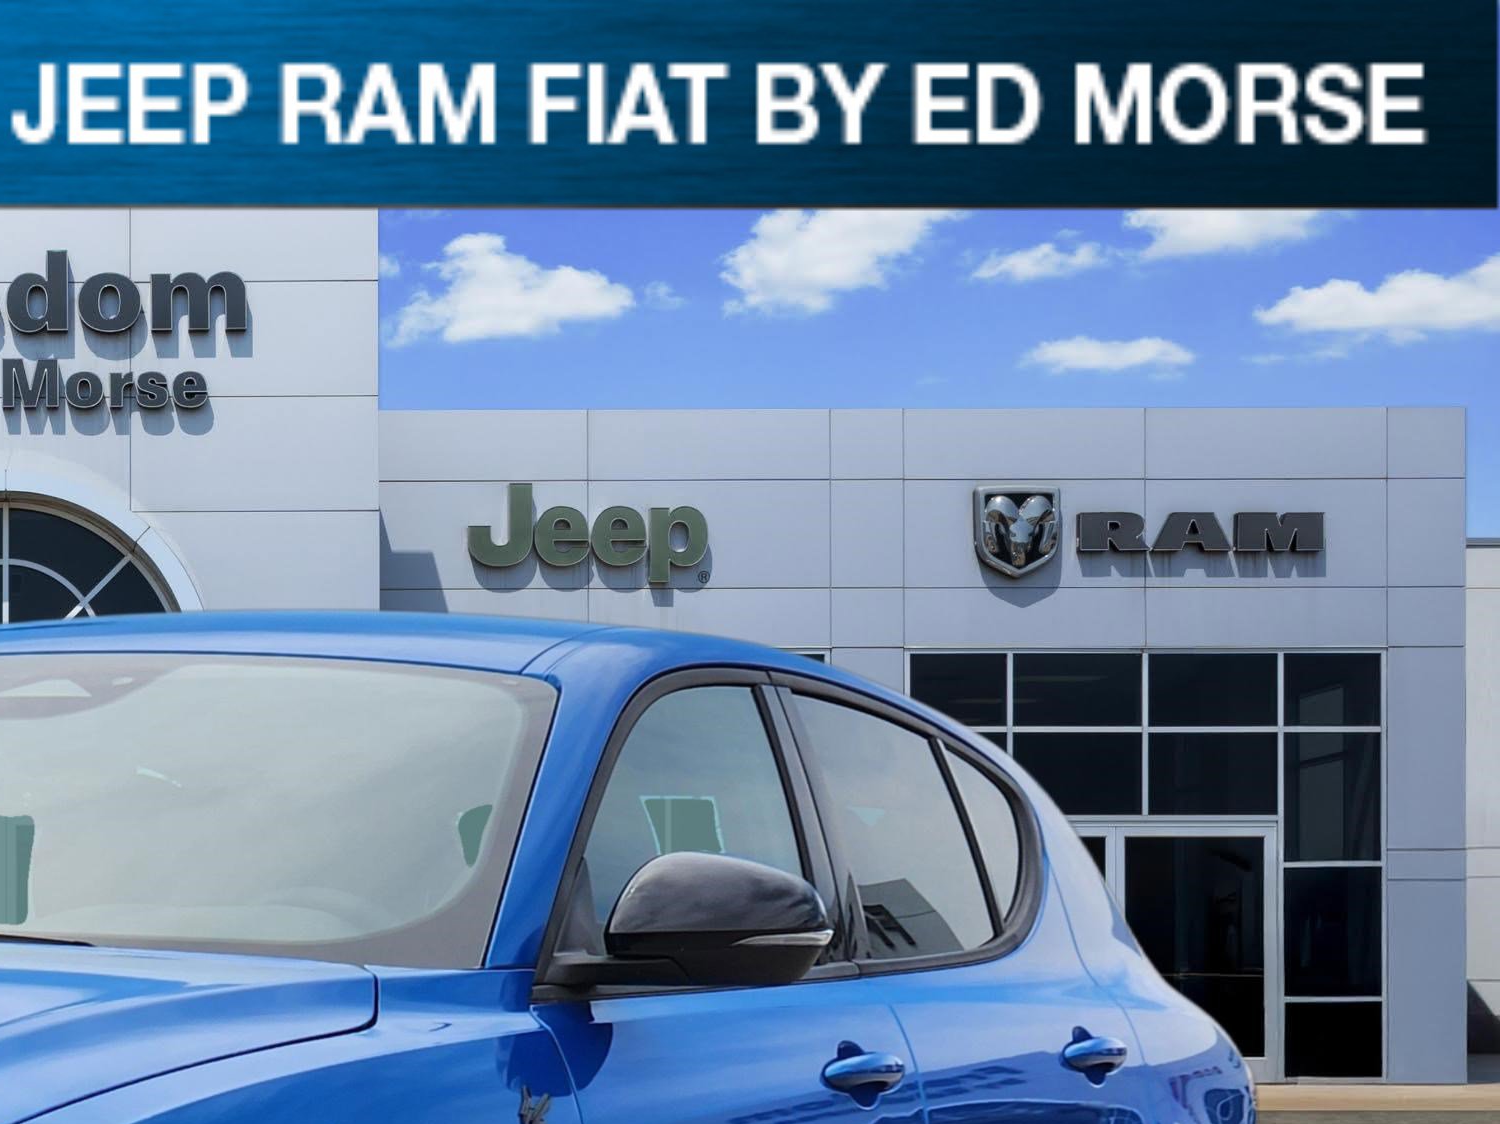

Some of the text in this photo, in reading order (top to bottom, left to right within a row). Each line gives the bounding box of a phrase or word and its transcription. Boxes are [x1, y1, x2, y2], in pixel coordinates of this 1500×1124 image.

[2, 358, 208, 409] Morse
[467, 482, 709, 583] Jeep
[1076, 511, 1325, 552] RAM
